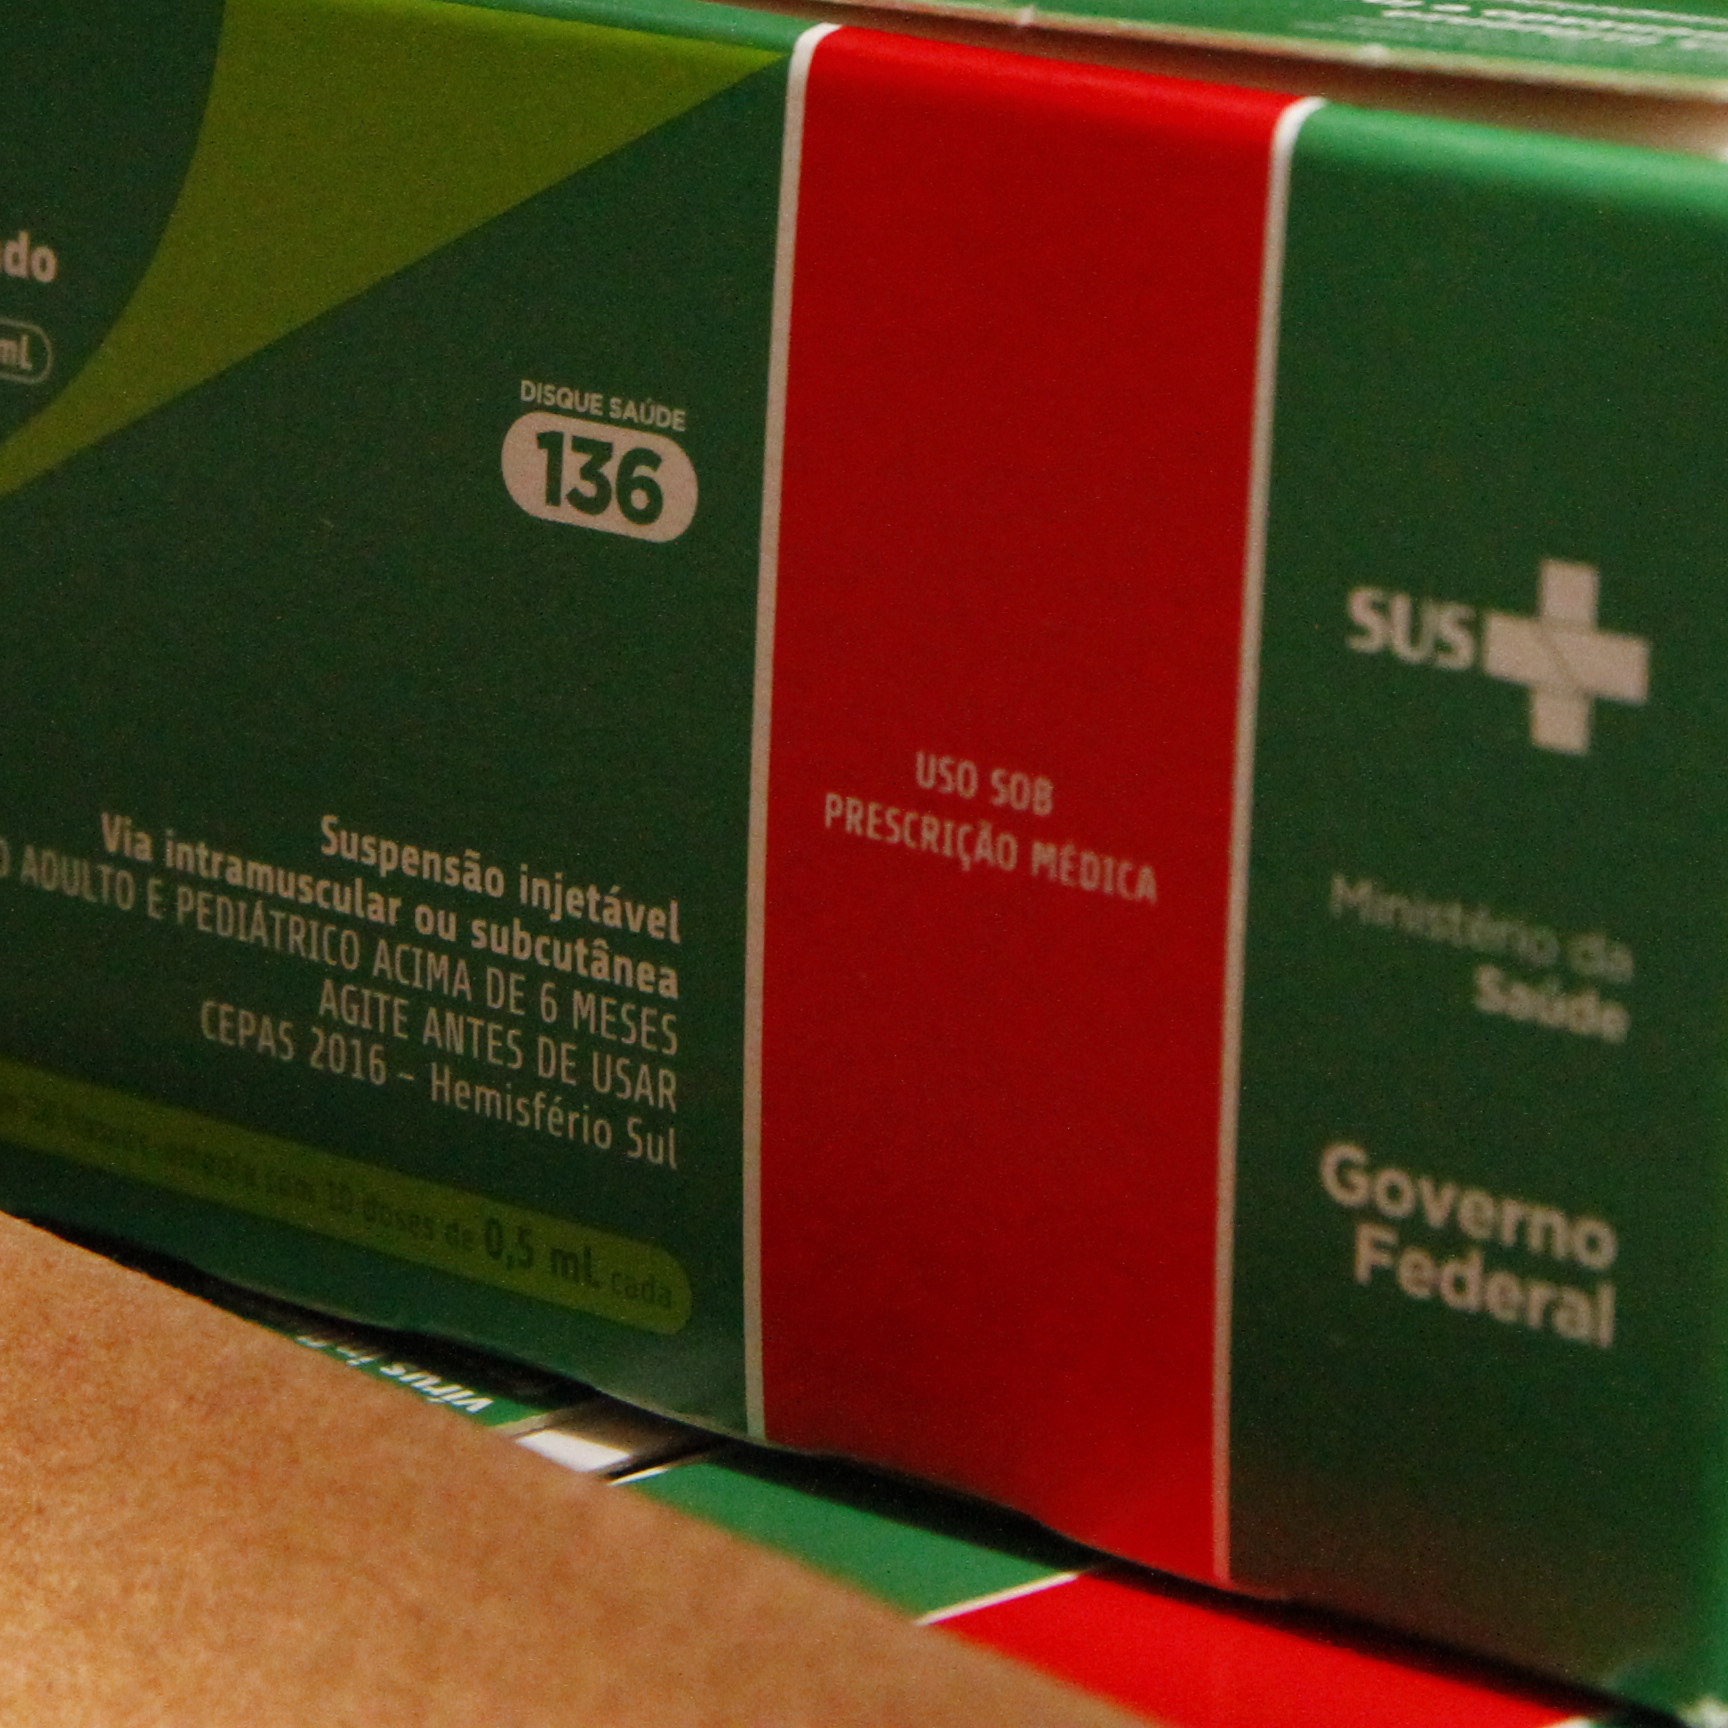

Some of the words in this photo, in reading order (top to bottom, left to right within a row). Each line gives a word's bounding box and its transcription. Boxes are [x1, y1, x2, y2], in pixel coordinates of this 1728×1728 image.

[520, 378, 604, 417] DISQUE
[608, 397, 687, 434] SAÚDE
[535, 429, 665, 527] 136
[1346, 584, 1475, 671] SUS
[915, 749, 980, 800] USO
[990, 767, 1055, 818] SOB
[100, 811, 154, 863] Via
[164, 828, 403, 927] intramuscular
[414, 903, 458, 943] ou
[471, 916, 680, 1000] subcutânea
[320, 813, 505, 898] Suspensão
[519, 863, 681, 944] injetável
[824, 790, 1018, 873] PRESCRIÇÃO
[1030, 837, 1158, 907] MÉDICA
[20, 842, 136, 912] ADULTO
[146, 876, 165, 921] E
[176, 884, 361, 971] PEDIÁTRICO
[372, 938, 473, 1002] ACIMA
[485, 965, 527, 1016] DE
[539, 981, 558, 1023] 6
[572, 989, 678, 1056] MESES
[1473, 963, 1631, 1045] Saúde
[200, 1000, 296, 1062] CEPAS
[309, 1026, 387, 1086] 2016
[430, 1061, 613, 1150] Hemisfério
[625, 1115, 678, 1171] Sul
[317, 978, 410, 1040] AGITE
[422, 1006, 524, 1071] ANTES
[537, 1034, 577, 1086] DE
[591, 1050, 677, 1113] USAR
[483, 1215, 535, 1271] 0,5
[549, 1243, 601, 1290] mL
[610, 1271, 674, 1308] cada
[1318, 1139, 1619, 1271] Governo
[1353, 1220, 1617, 1350] Federal
